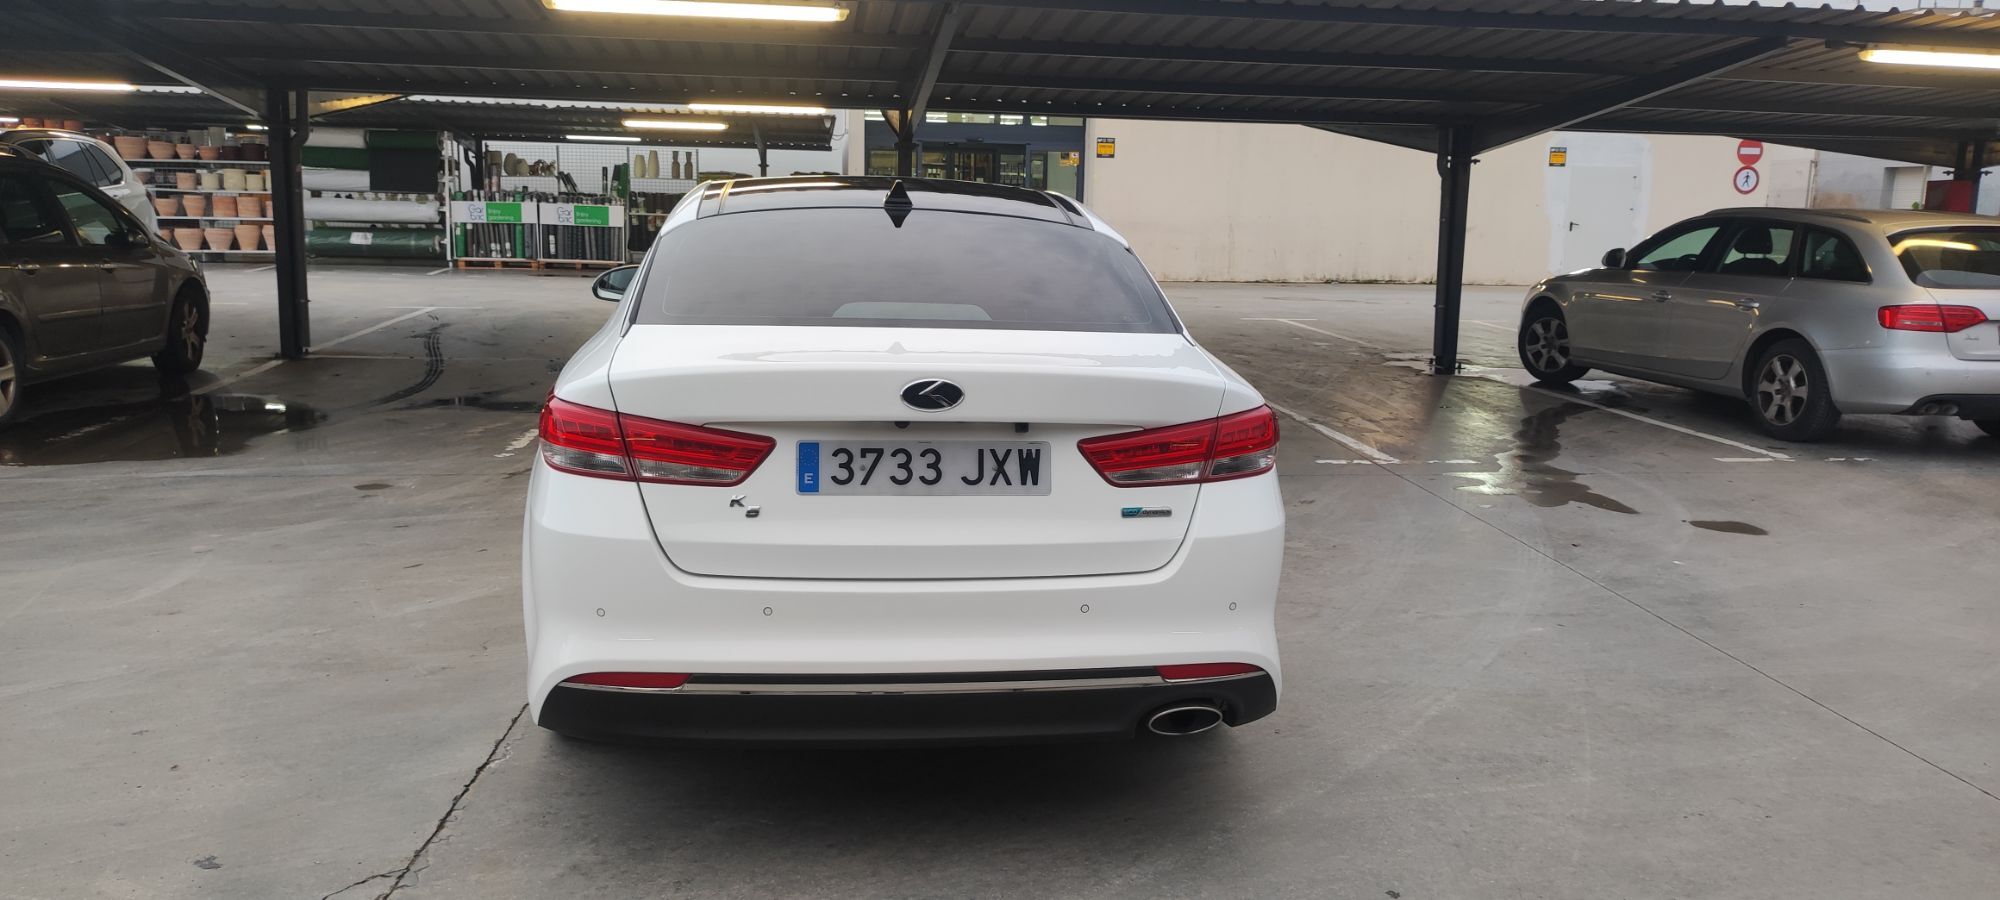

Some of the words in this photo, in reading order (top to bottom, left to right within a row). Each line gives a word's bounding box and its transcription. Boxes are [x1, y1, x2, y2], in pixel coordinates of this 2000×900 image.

[803, 472, 814, 484] E
[830, 447, 943, 486] 3733
[960, 448, 1041, 486] JXW
